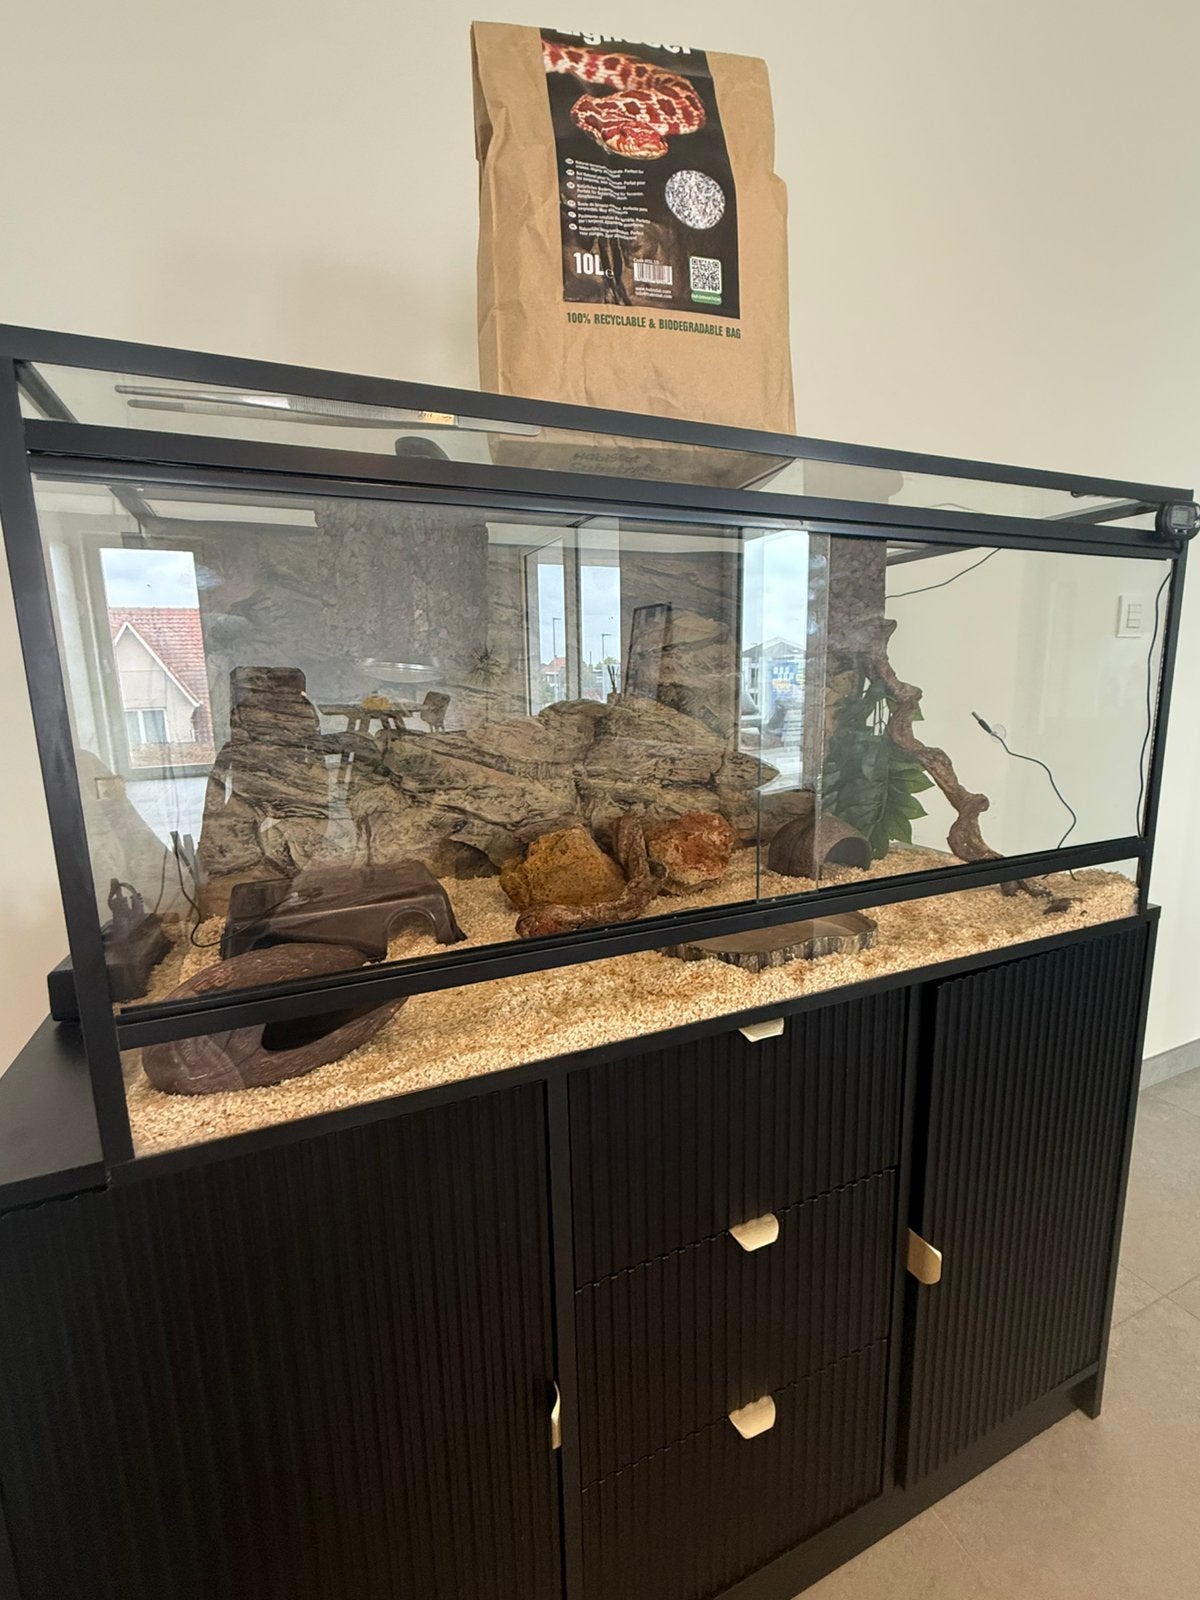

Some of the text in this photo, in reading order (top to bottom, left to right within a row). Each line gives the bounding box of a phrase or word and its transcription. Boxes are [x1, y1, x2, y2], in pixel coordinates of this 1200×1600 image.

[573, 252, 604, 276] 10L
[566, 312, 741, 339] 100% RECYCLABLE & BIODEGRADABLE BAG
